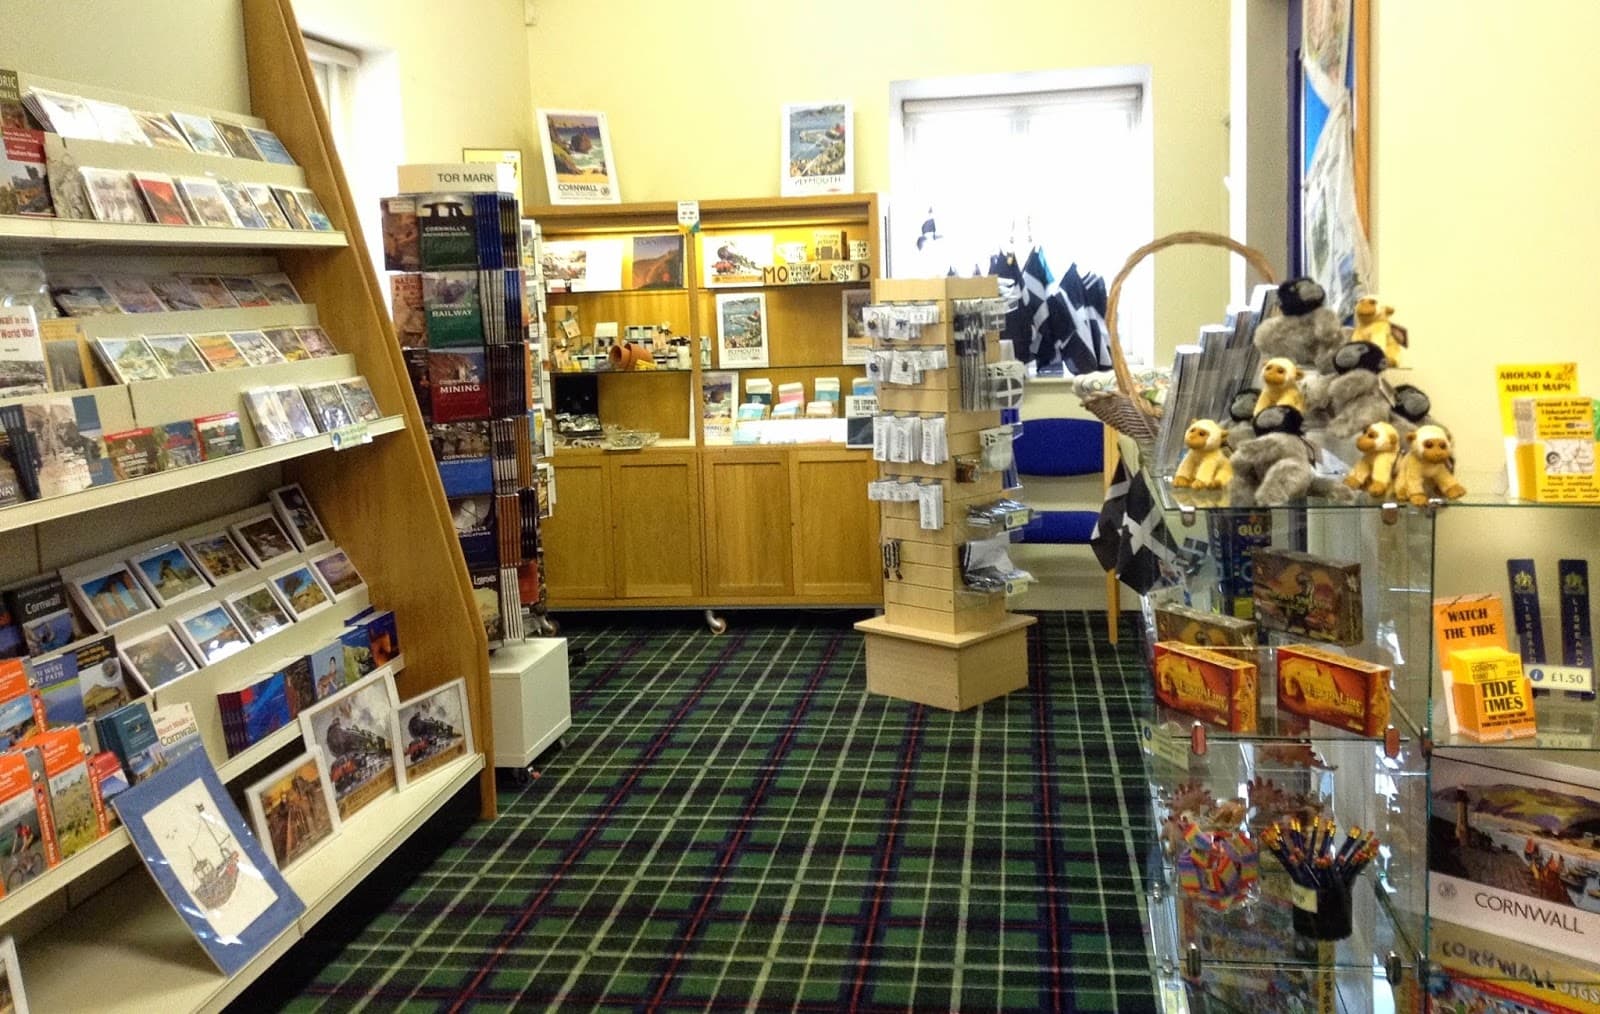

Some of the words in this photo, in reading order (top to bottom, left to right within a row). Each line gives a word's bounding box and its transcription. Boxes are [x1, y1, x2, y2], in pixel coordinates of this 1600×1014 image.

[437, 173, 460, 183] TOR
[463, 173, 494, 183] MARK
[557, 183, 598, 192] CORNWALL
[431, 310, 472, 318] RAILWAY
[1500, 371, 1542, 380] AROUND
[440, 384, 480, 394] MINING
[1505, 383, 1540, 392] ABOUT
[1543, 383, 1571, 391] MAPS
[24, 593, 61, 615] Cornwall
[1447, 607, 1488, 622] WATCH
[1444, 626, 1466, 640] THE
[1470, 623, 1497, 637] TIDE
[1551, 672, 1584, 684] £1.50
[1481, 680, 1520, 698] TIDE
[1483, 696, 1524, 712] TIMES
[160, 721, 198, 747] Cornwall
[1475, 891, 1584, 935] CORNWALL
[1441, 941, 1556, 991] CORNWALL
